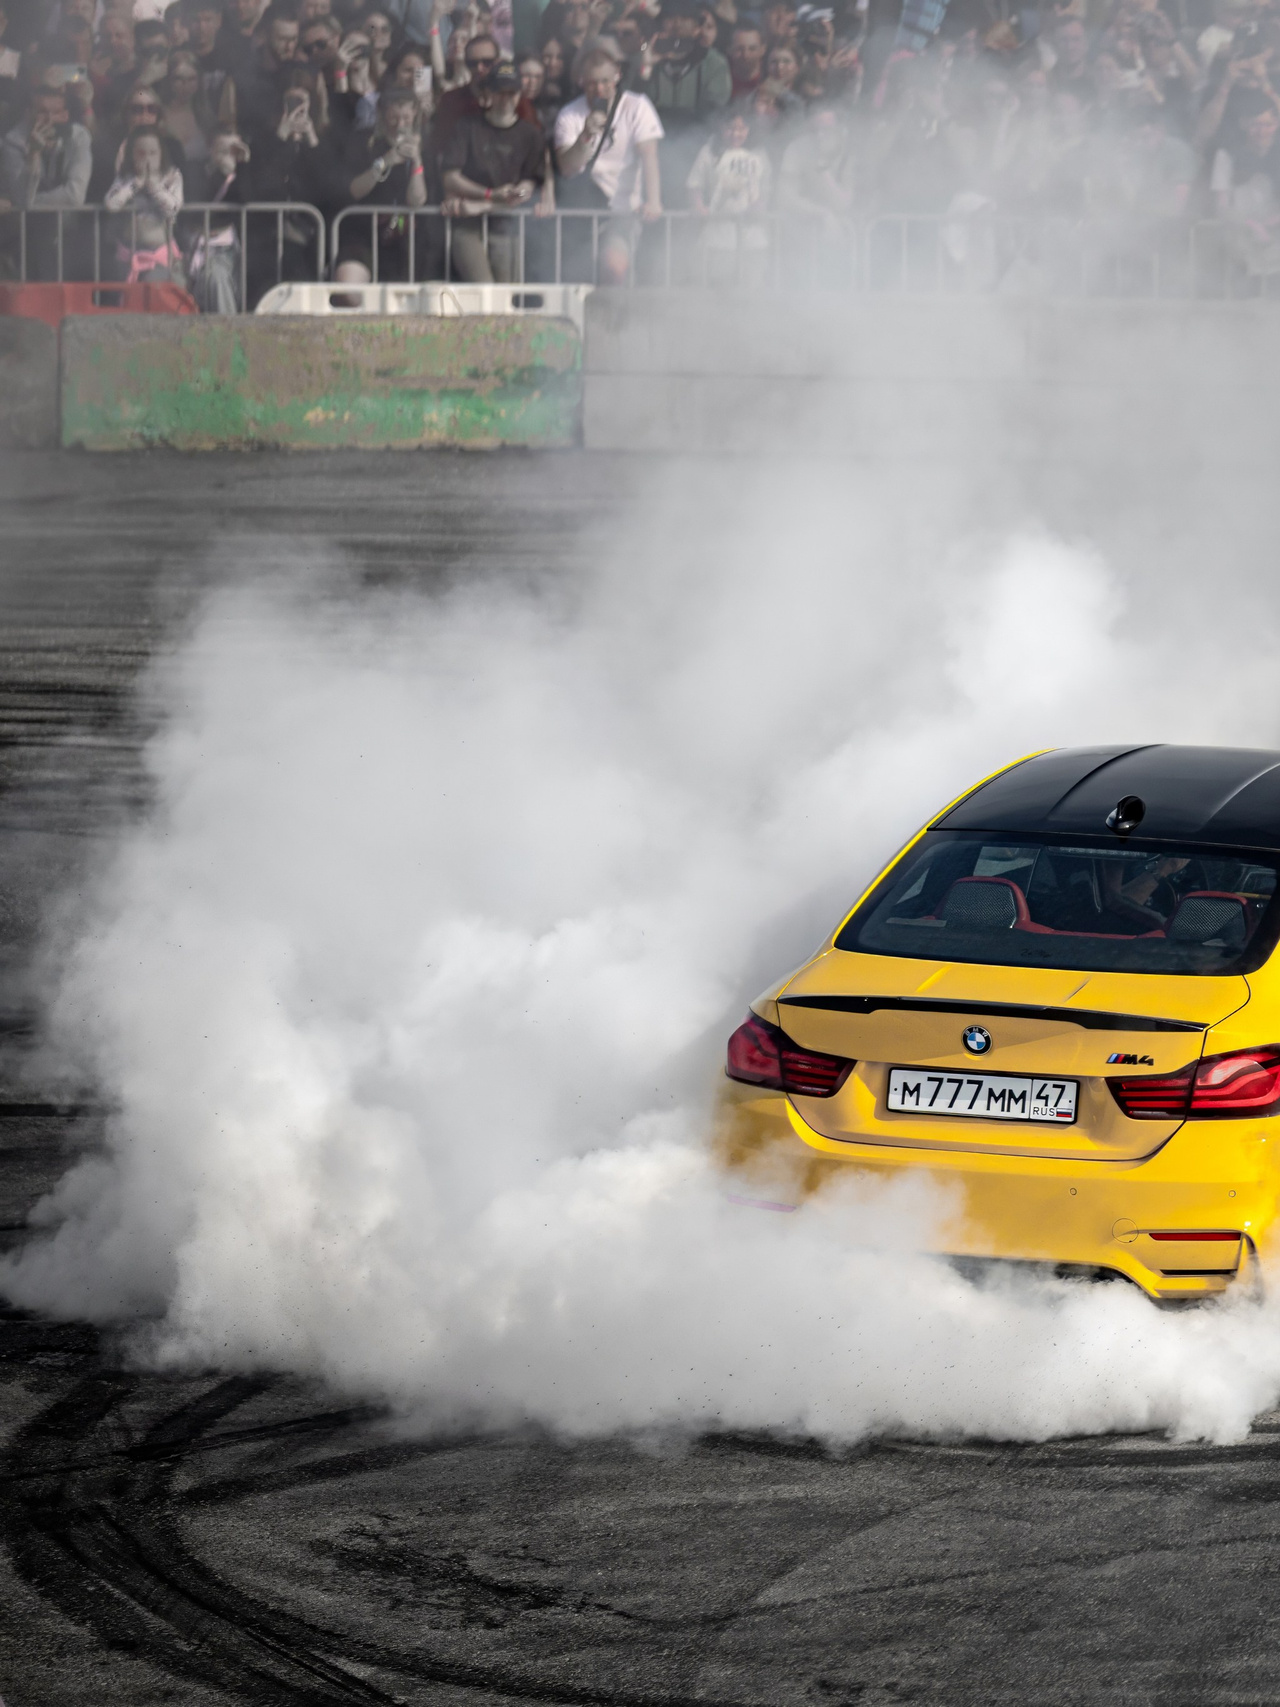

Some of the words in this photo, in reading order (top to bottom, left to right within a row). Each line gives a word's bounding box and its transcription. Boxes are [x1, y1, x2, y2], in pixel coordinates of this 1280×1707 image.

[1118, 1053, 1154, 1066] M4
[1036, 1083, 1066, 1107] 47
[1032, 1107, 1055, 1117] RUS
